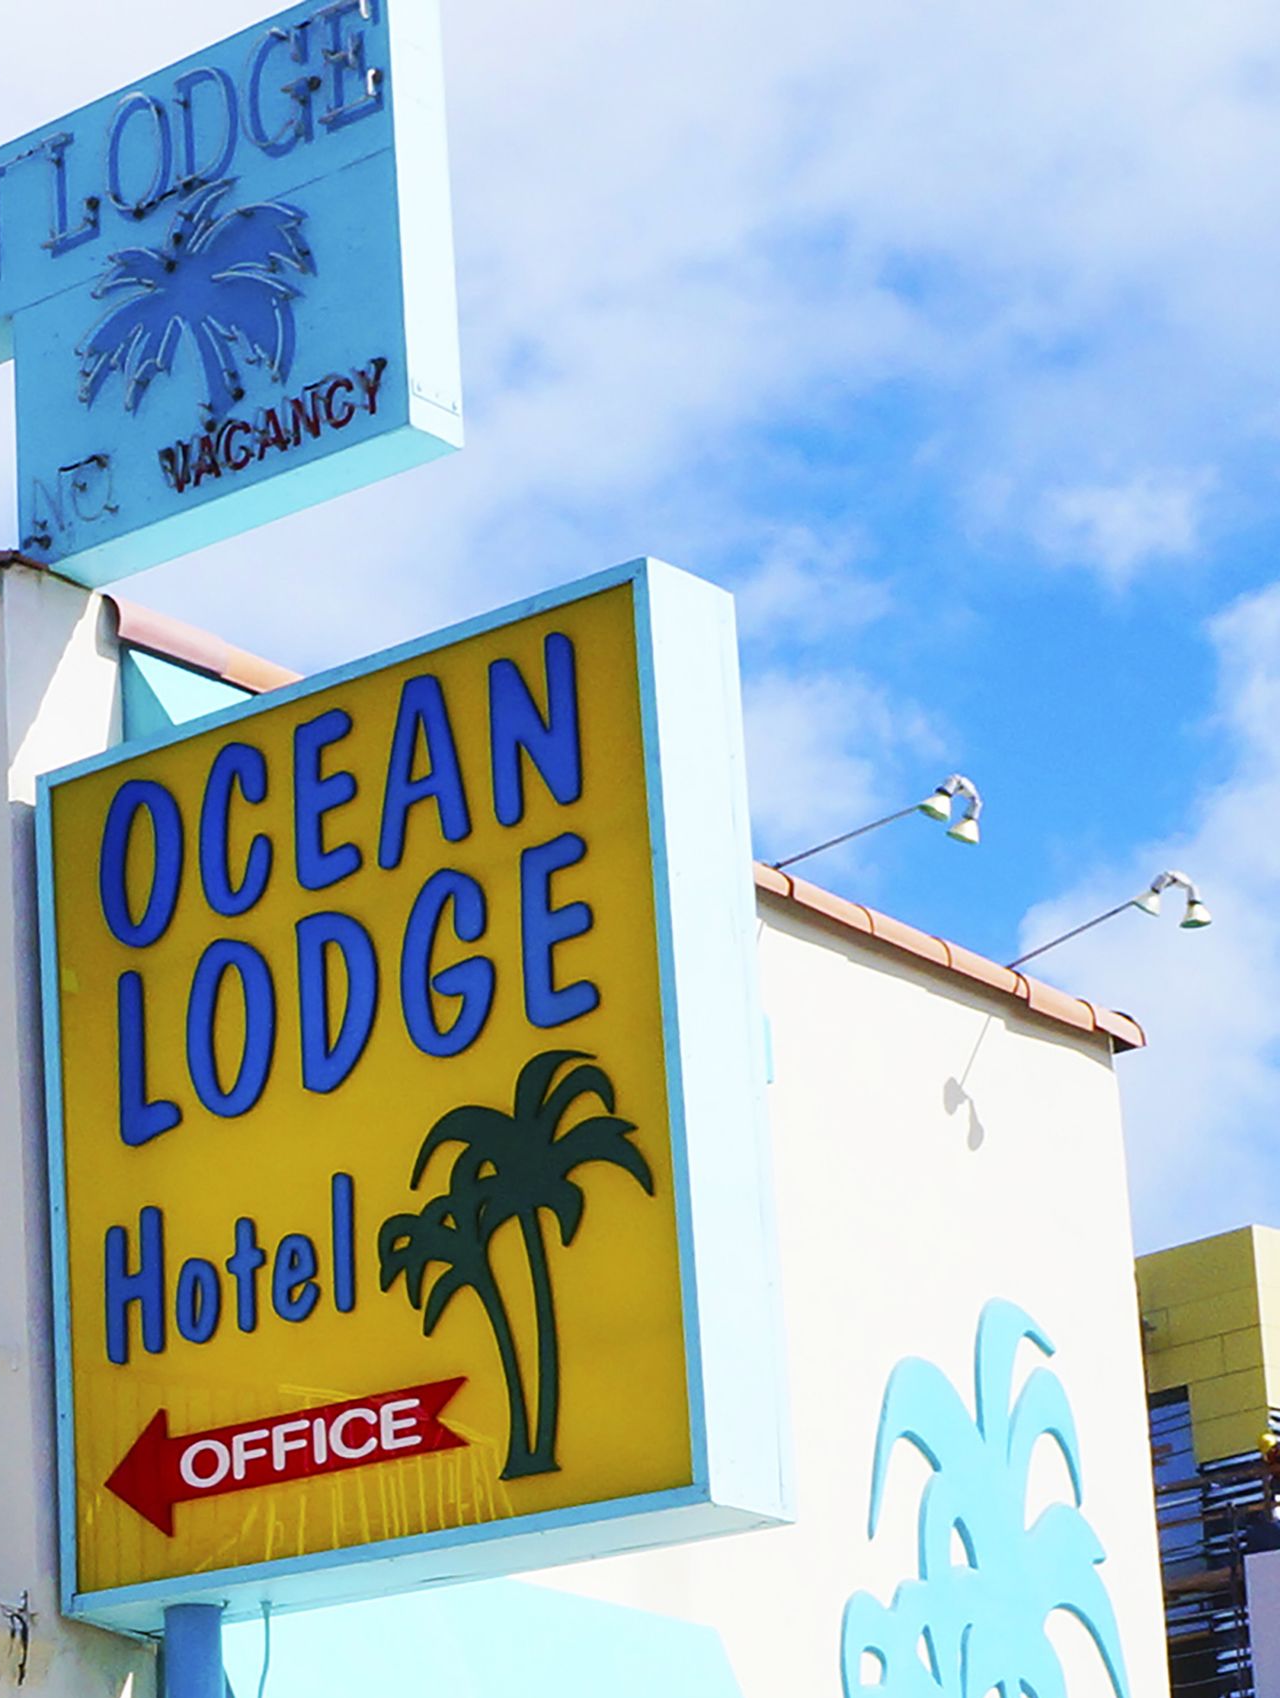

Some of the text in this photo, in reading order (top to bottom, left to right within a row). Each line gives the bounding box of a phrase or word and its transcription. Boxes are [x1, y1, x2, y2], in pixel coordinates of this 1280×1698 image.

[41, 0, 384, 258] LODGE
[158, 357, 388, 493] VACANCY
[99, 631, 583, 948] OCEAN
[117, 832, 600, 1147] LODGE
[104, 1172, 355, 1364] Hotel
[179, 1398, 422, 1489] OFFICE
